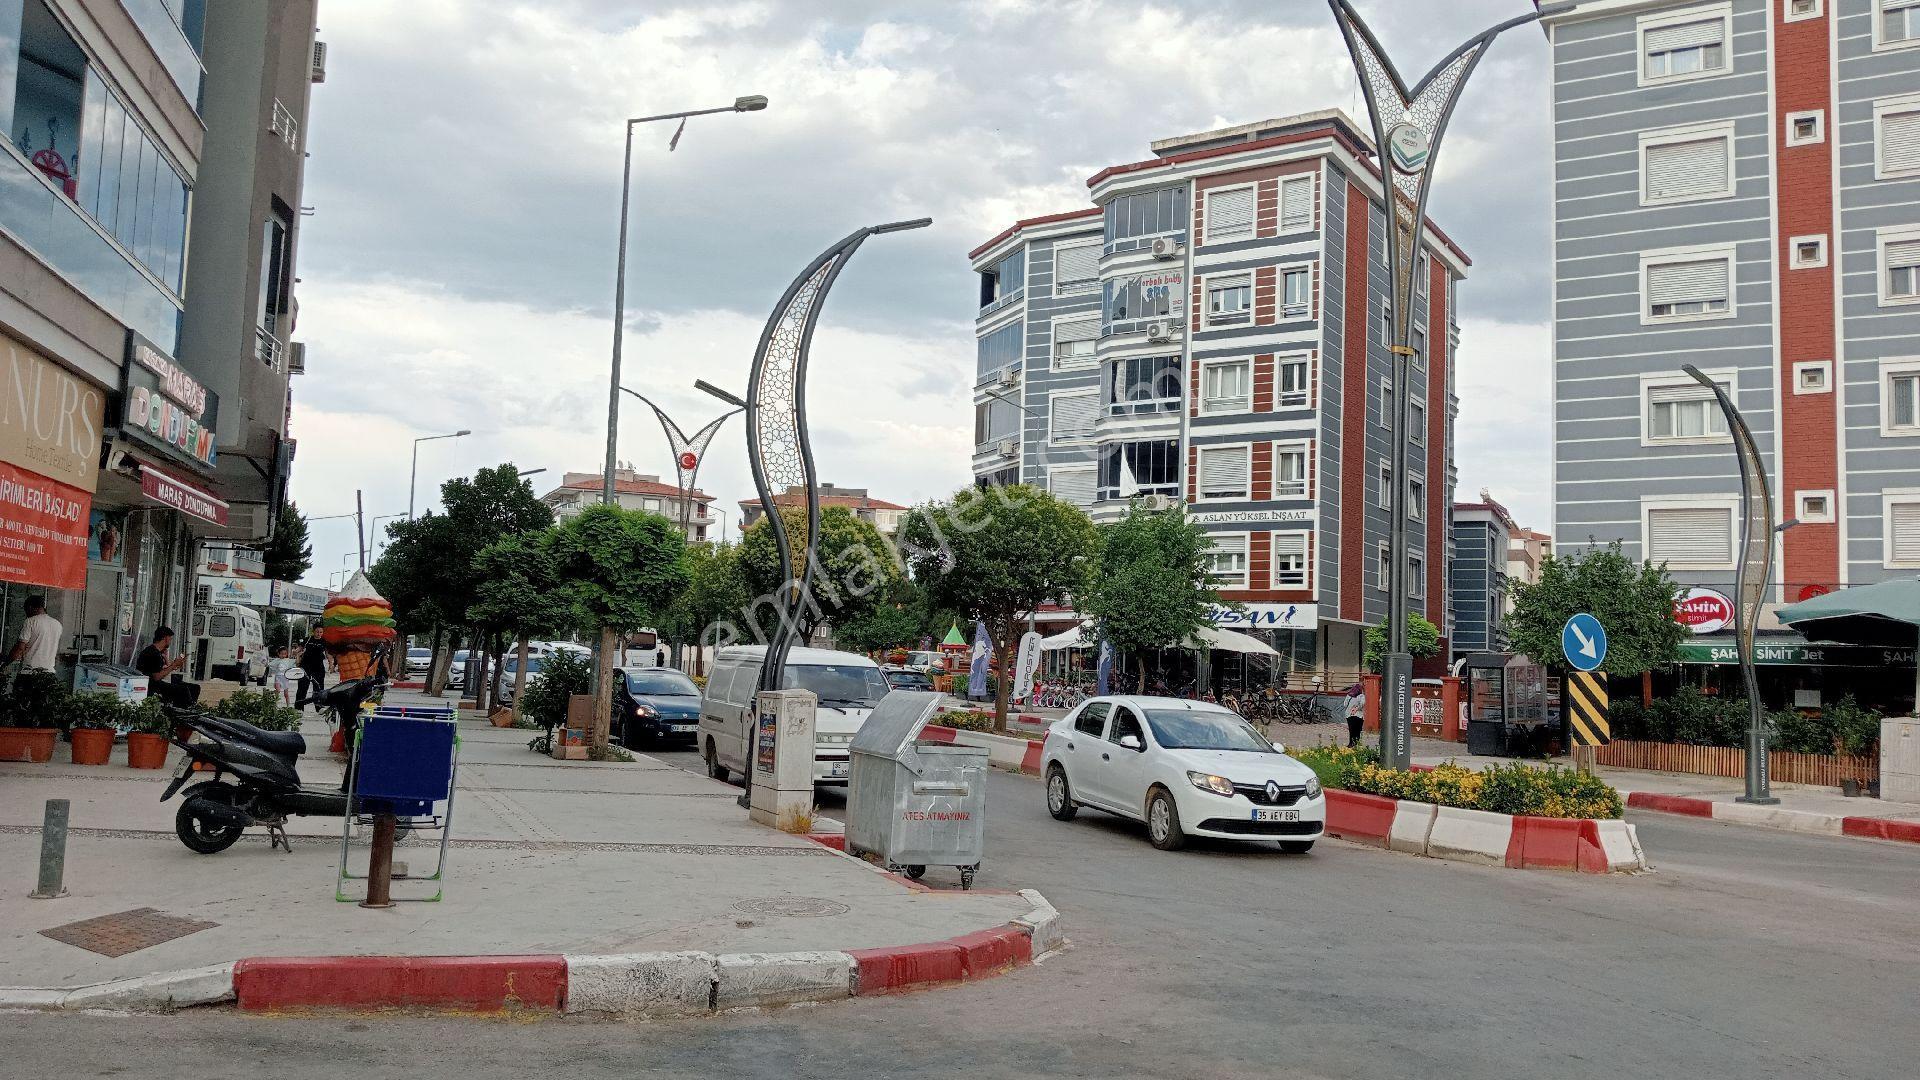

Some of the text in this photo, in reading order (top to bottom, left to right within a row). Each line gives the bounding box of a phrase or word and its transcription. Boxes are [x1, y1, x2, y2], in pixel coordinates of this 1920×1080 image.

[4, 346, 98, 477] NURŞ
[129, 385, 216, 468] DONDURMA
[158, 483, 217, 520] MARAŞ DONDURMA
[1203, 510, 1307, 522] ASLAN YÜKSEL İNŞAAT
[1710, 648, 1738, 661] ŞAH
[1756, 646, 1794, 660] SİMİT
[1397, 673, 1406, 756] TORBALI BELEDİYESİ
[926, 811, 970, 821] ATMAYINIZ
